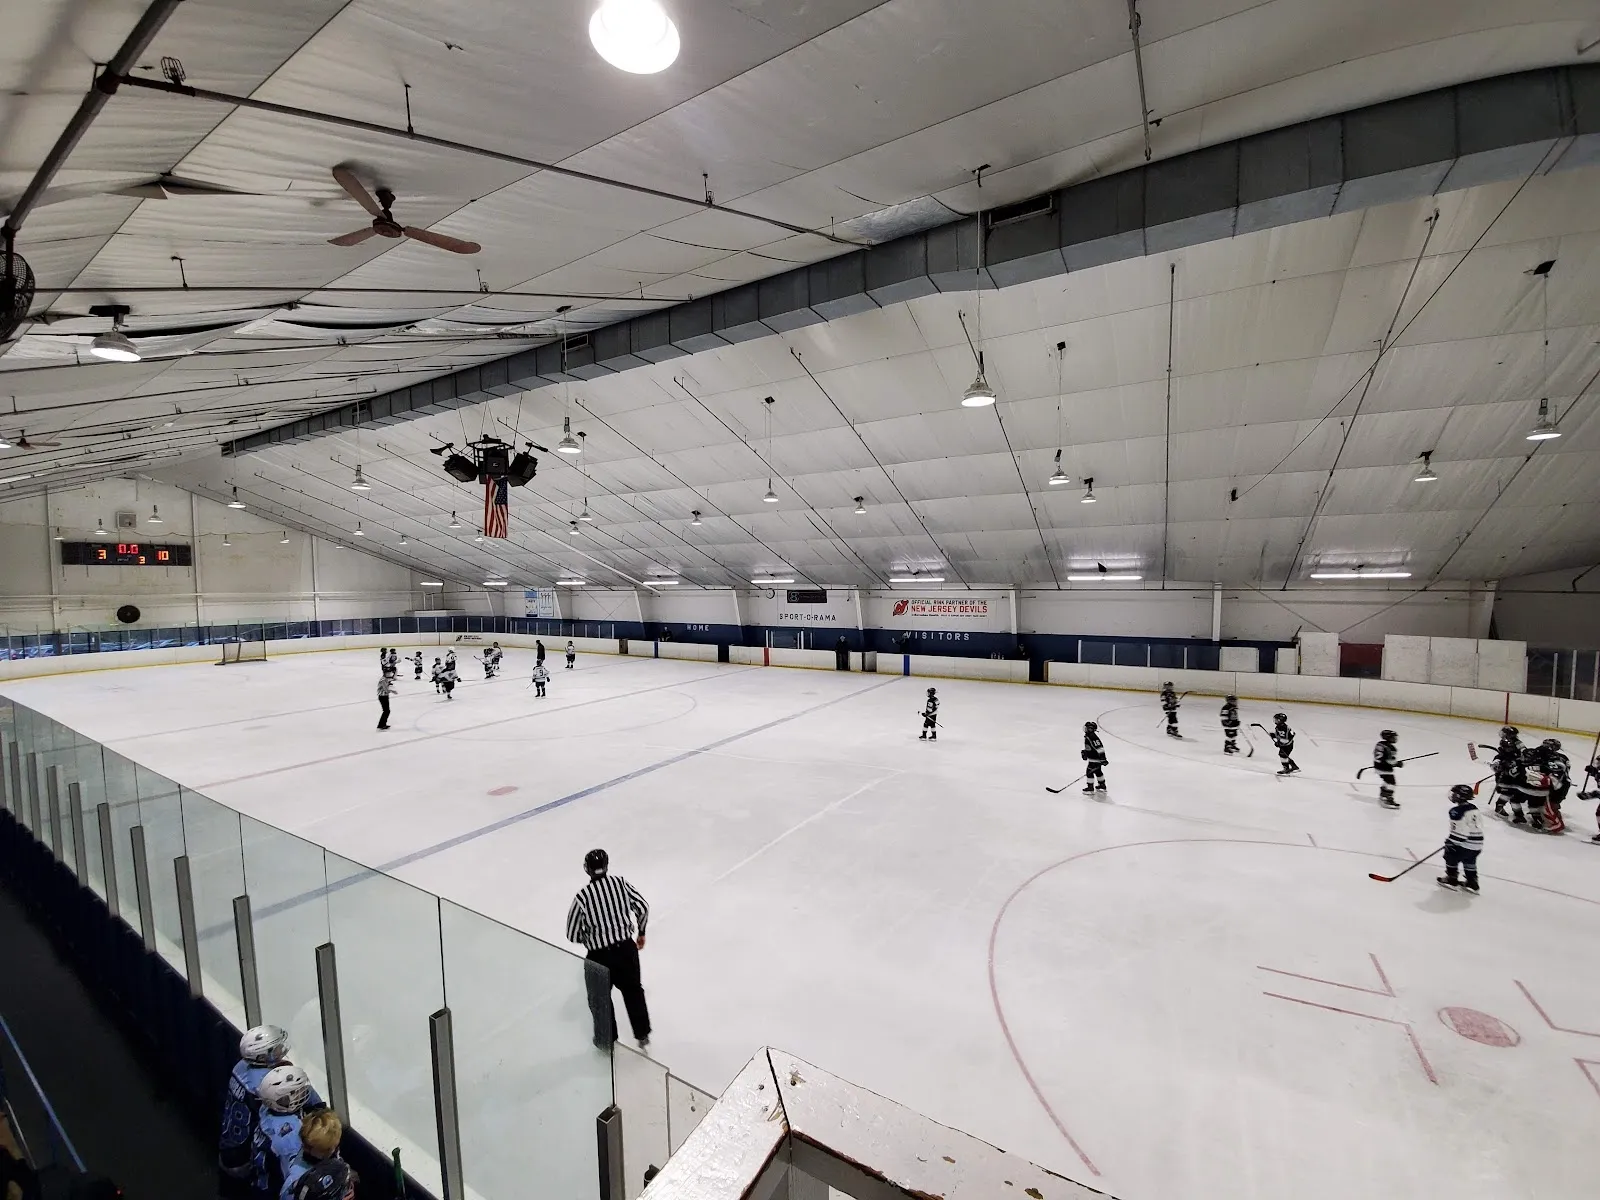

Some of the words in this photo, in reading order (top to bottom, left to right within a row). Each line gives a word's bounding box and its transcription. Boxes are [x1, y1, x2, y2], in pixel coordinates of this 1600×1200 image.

[118, 544, 139, 554] 0.0
[98, 549, 107, 560] 3
[158, 551, 169, 560] 10
[139, 556, 146, 564] 3
[928, 605, 957, 613] JERSEY
[779, 613, 836, 622] SPORT-O-RAMA
[905, 631, 970, 641] VISITORS
